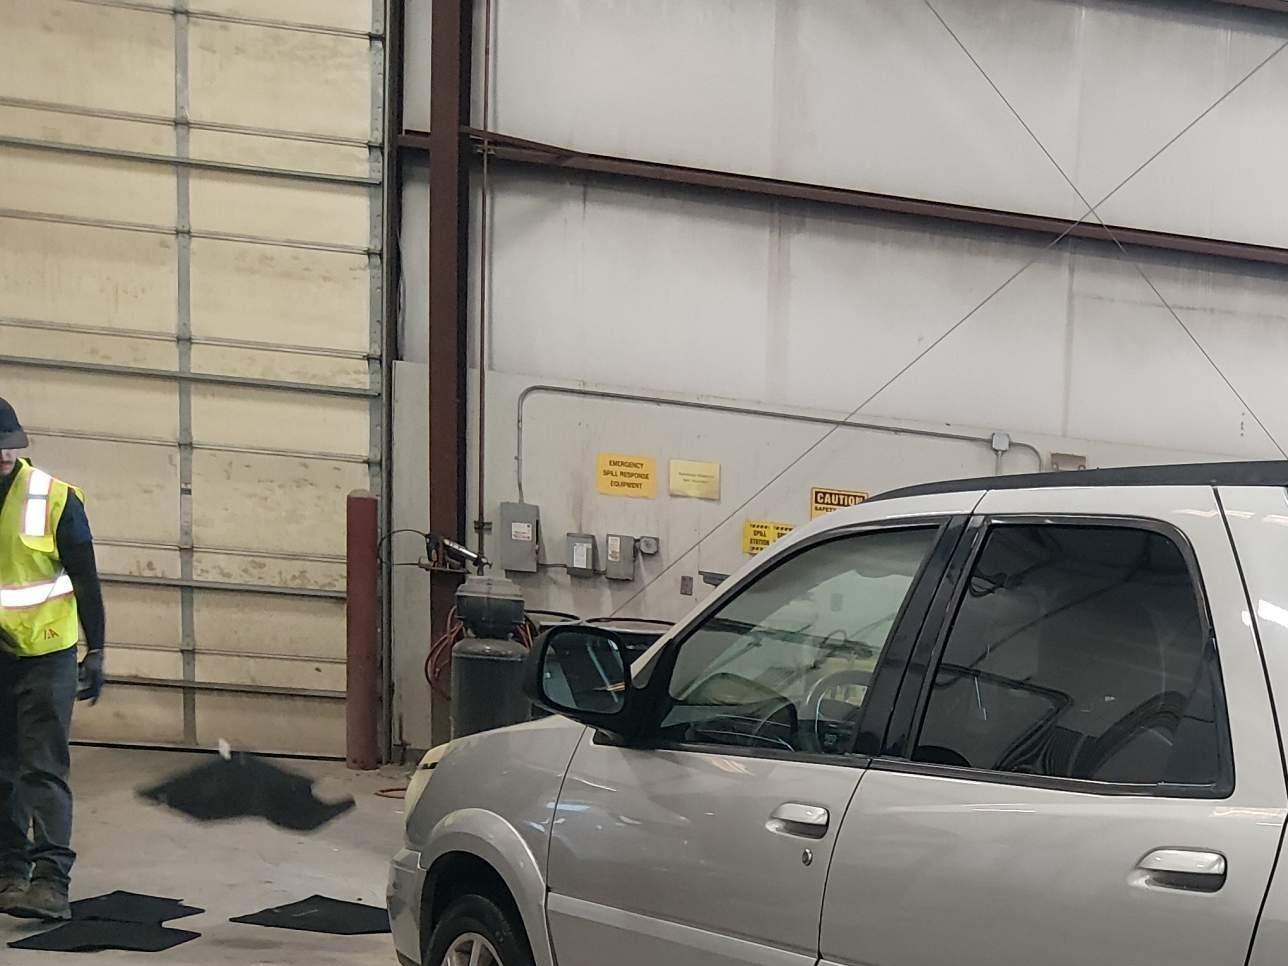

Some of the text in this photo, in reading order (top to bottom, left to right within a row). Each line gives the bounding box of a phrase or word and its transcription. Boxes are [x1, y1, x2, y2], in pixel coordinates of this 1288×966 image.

[608, 460, 644, 469] EMERGENCY
[620, 471, 649, 480] RESPONSE
[610, 480, 642, 489] EQUIPMENT
[817, 493, 864, 506] CAUTION
